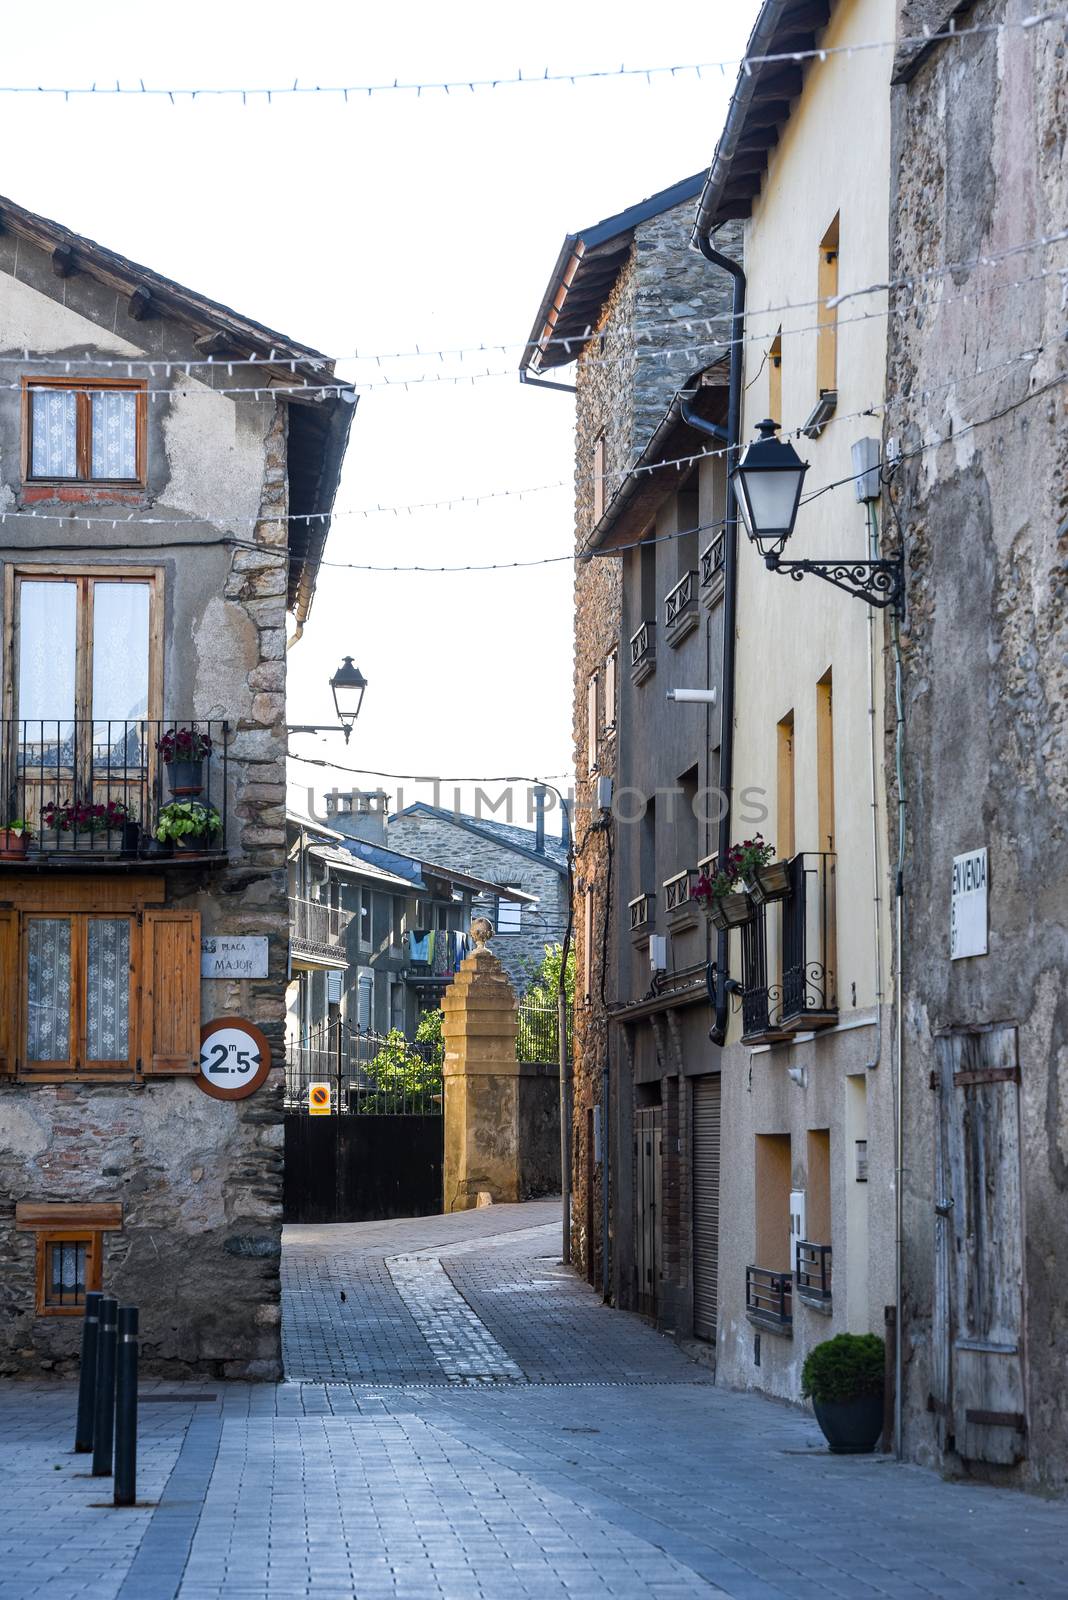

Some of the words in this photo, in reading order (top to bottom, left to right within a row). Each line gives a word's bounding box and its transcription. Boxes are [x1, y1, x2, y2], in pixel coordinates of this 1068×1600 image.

[953, 863, 961, 895] EN
[961, 854, 986, 892] VENDA
[214, 959, 253, 971] MAJOR
